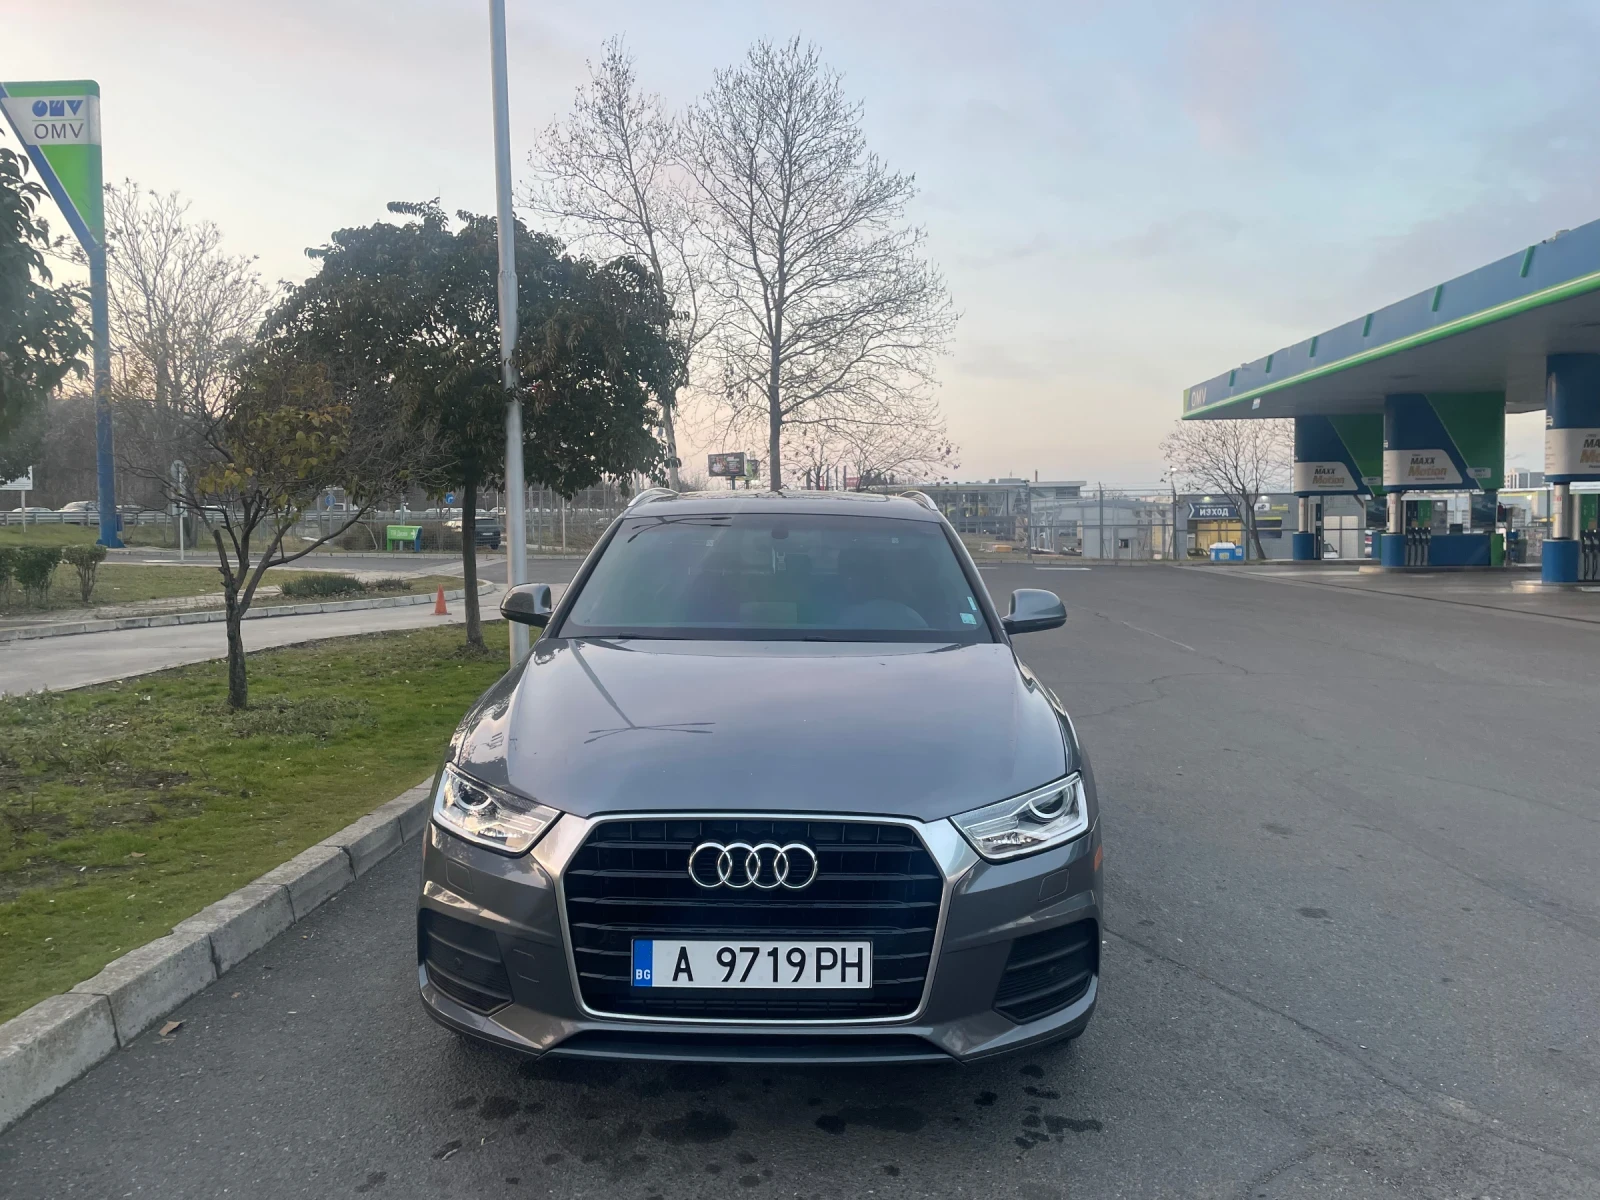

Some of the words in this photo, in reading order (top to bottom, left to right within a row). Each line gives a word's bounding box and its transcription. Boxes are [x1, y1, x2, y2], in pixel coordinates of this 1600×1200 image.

[34, 123, 84, 139] OMV
[1191, 387, 1207, 407] OMV
[1410, 457, 1436, 465] MAXX
[1408, 465, 1448, 476] Motion
[1312, 475, 1345, 484] Motion
[1199, 508, 1229, 517] ИЗХОД
[672, 946, 694, 982] A
[635, 968, 651, 980] BG
